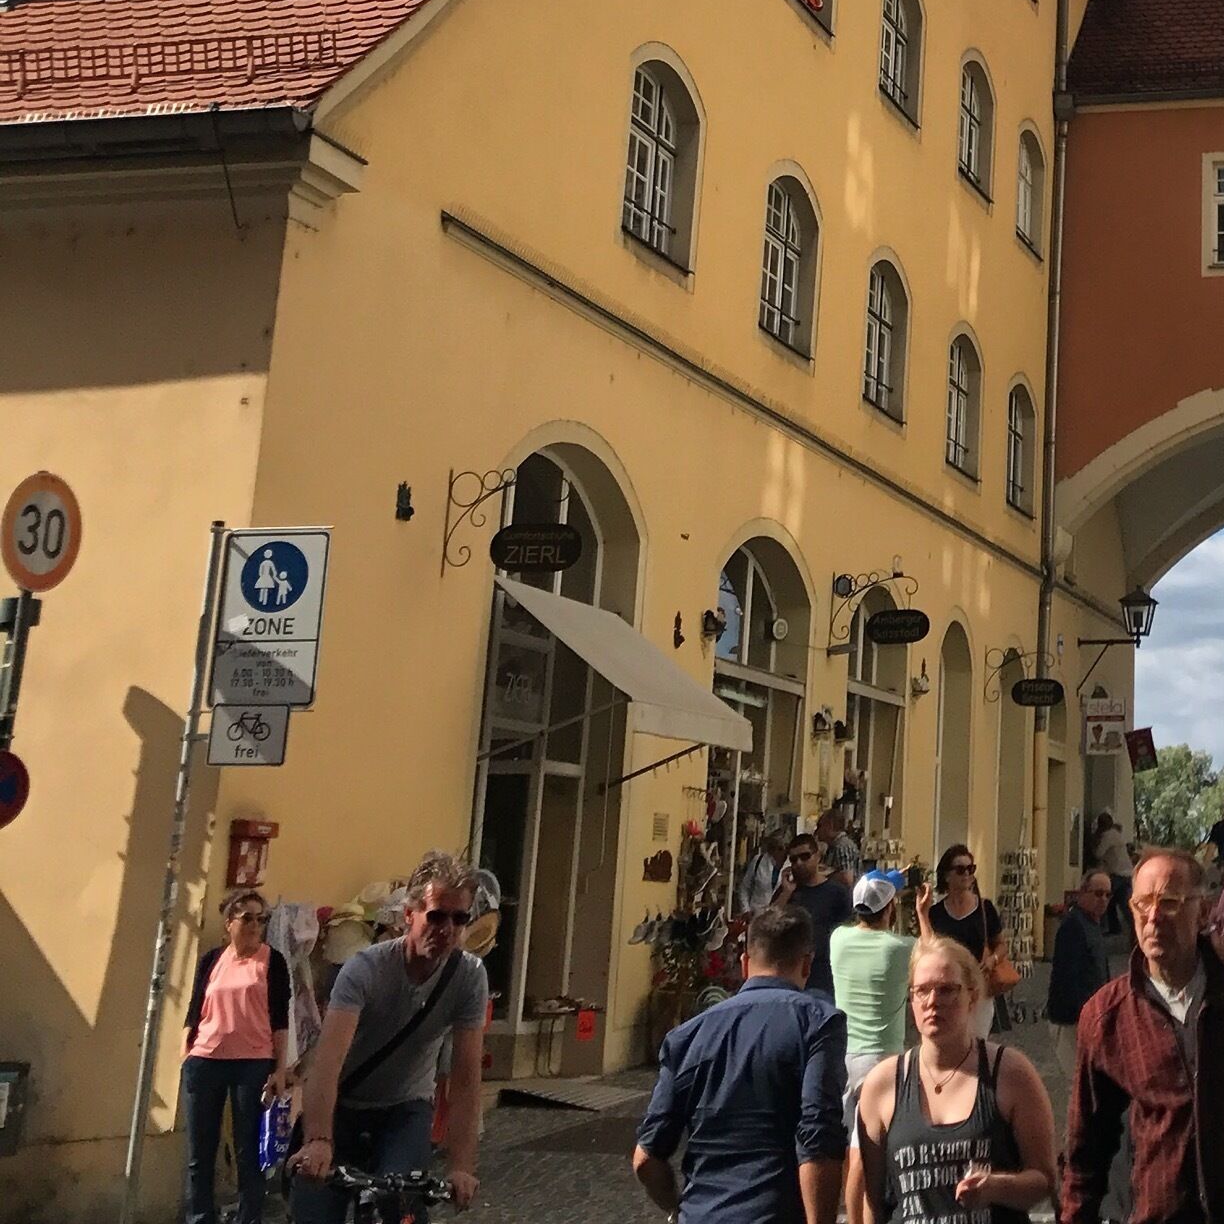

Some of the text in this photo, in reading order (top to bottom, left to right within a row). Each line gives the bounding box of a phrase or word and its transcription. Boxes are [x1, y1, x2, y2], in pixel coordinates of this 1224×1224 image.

[18, 504, 65, 559] 30
[504, 545, 566, 564] ZIERL
[242, 617, 295, 635] ZONE
[234, 744, 259, 759] frei
